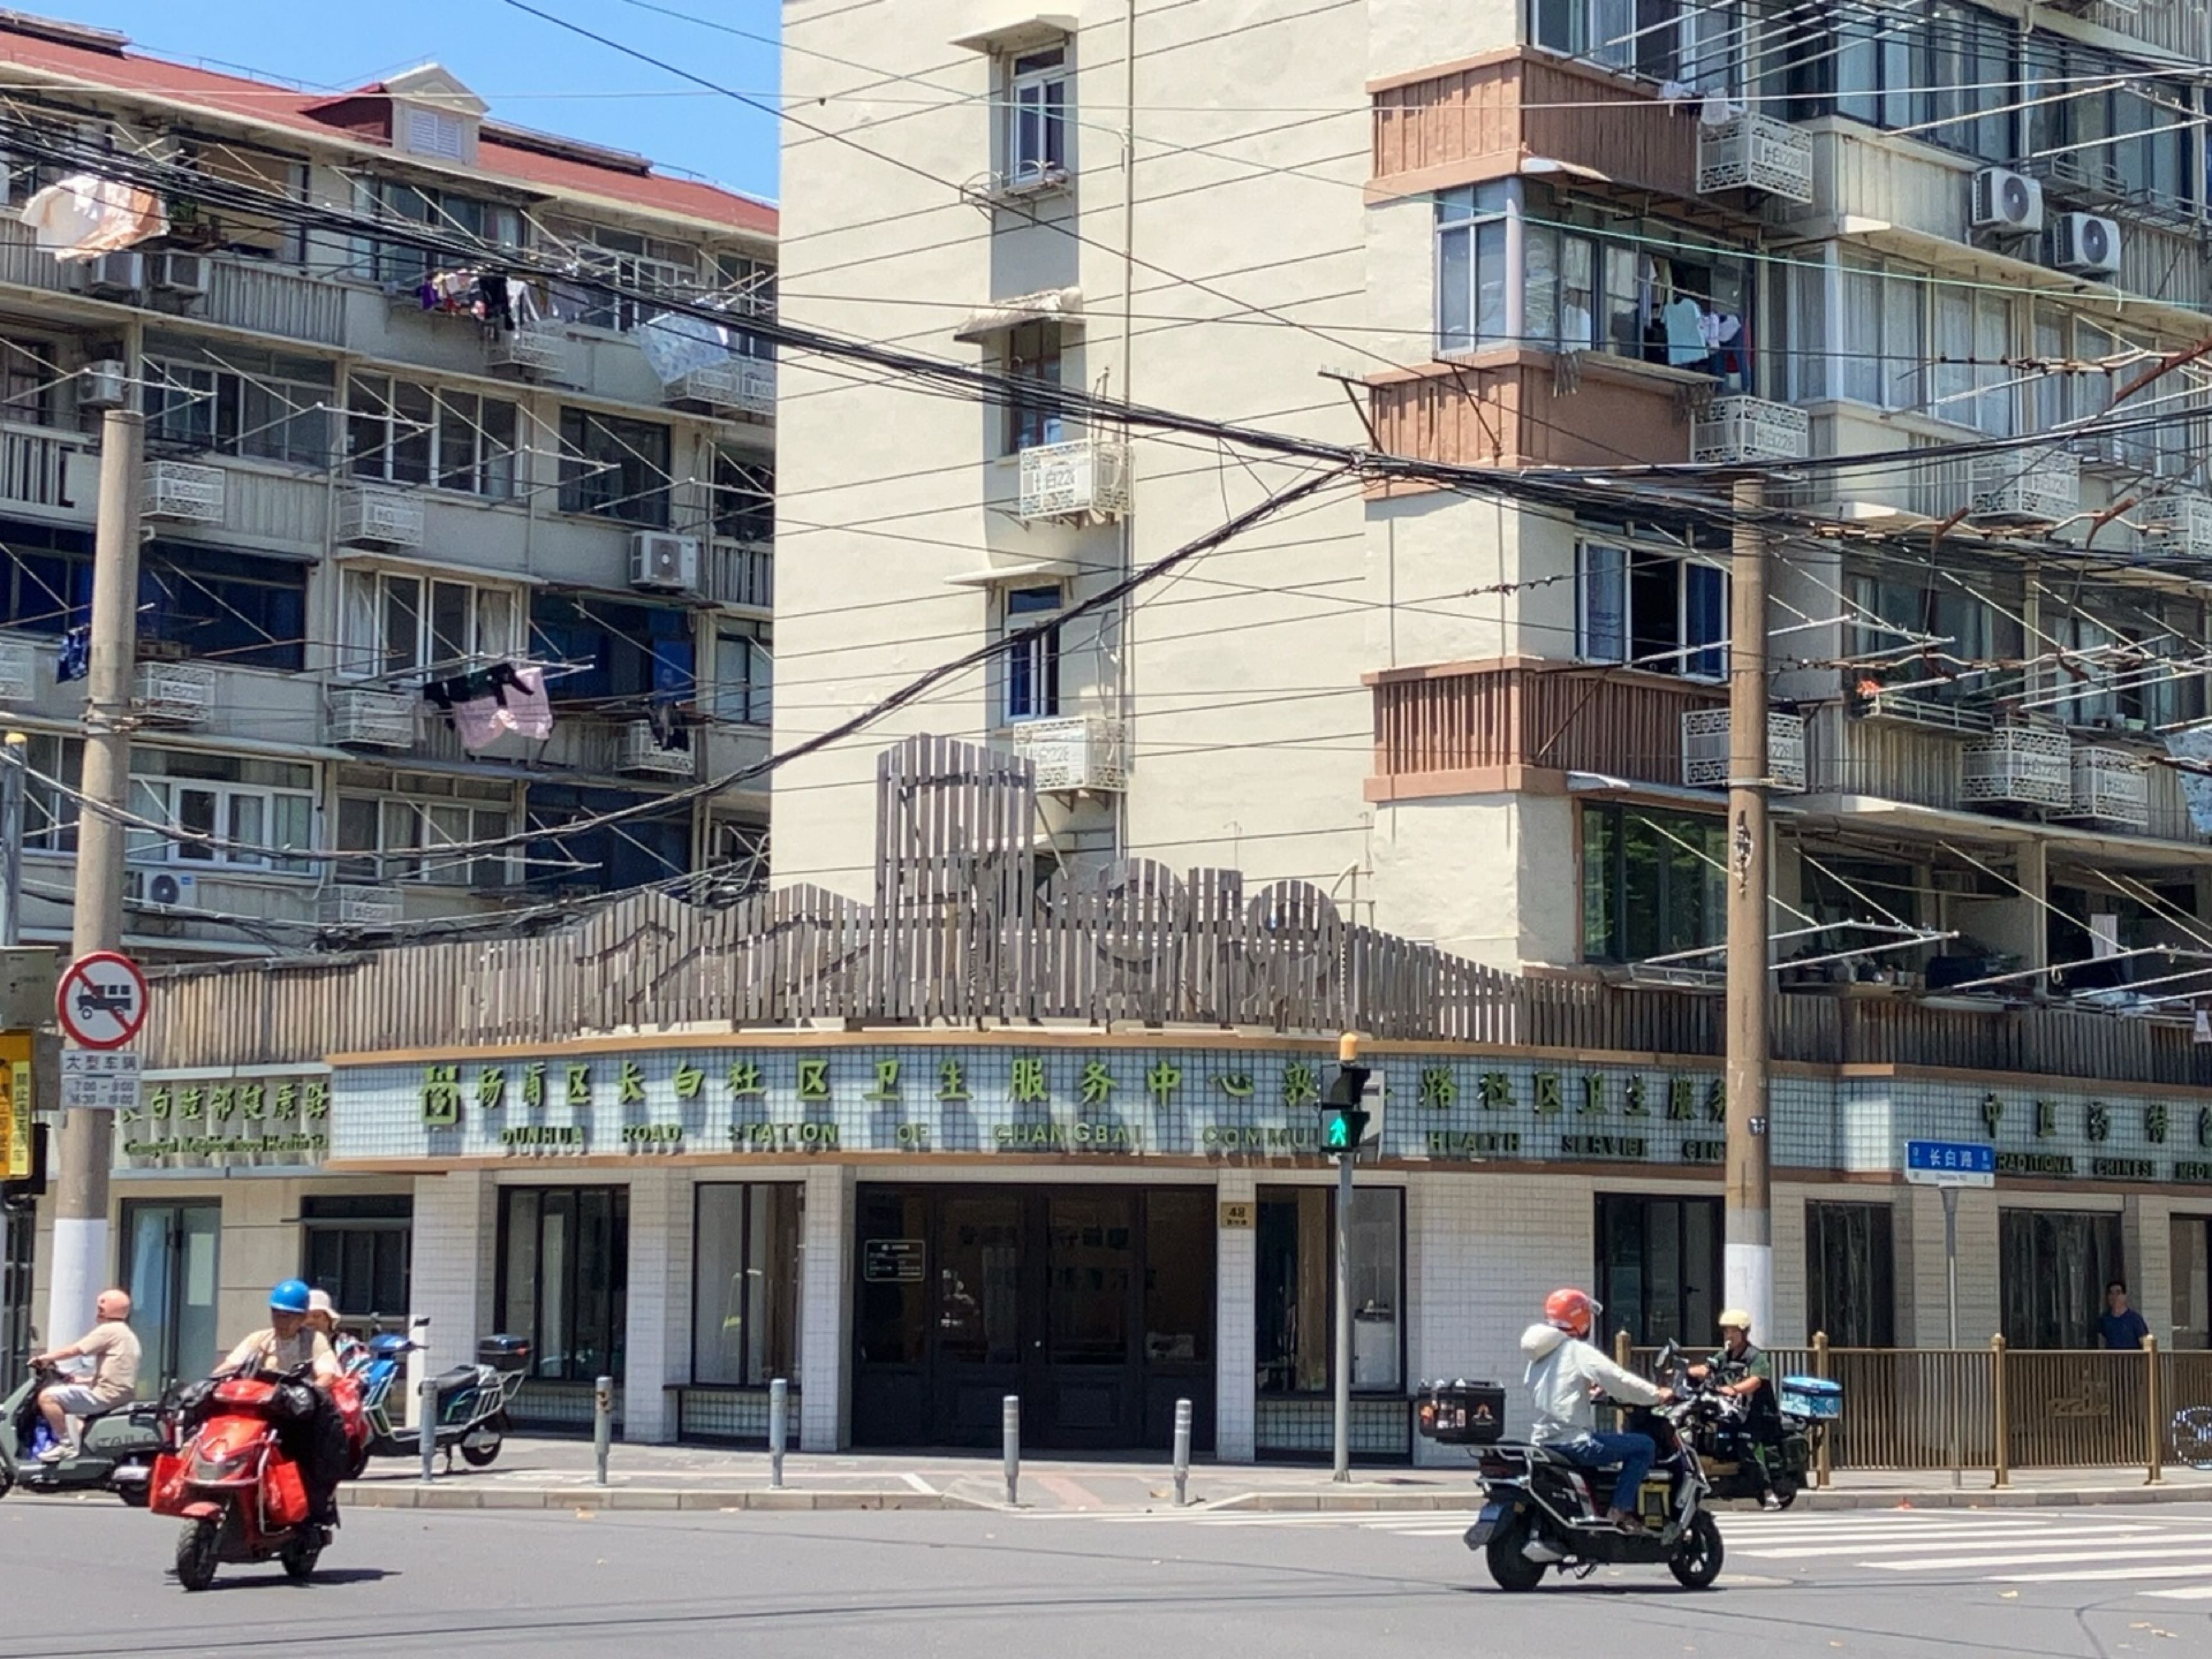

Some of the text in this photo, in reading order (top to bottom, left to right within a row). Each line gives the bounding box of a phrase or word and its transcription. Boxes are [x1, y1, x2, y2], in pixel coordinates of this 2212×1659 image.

[66, 1055, 136, 1070] 大型车辆
[622, 1123, 682, 1143] ROAD
[728, 1123, 840, 1142] STATION
[897, 1123, 928, 1143] OF
[993, 1123, 1142, 1146] CHANGBAI
[1681, 1141, 1726, 1160] CEN
[1930, 1148, 1973, 1168] 长白路
[1995, 1153, 2078, 1175] RADITIONAL
[2174, 1161, 2212, 1181] MED
